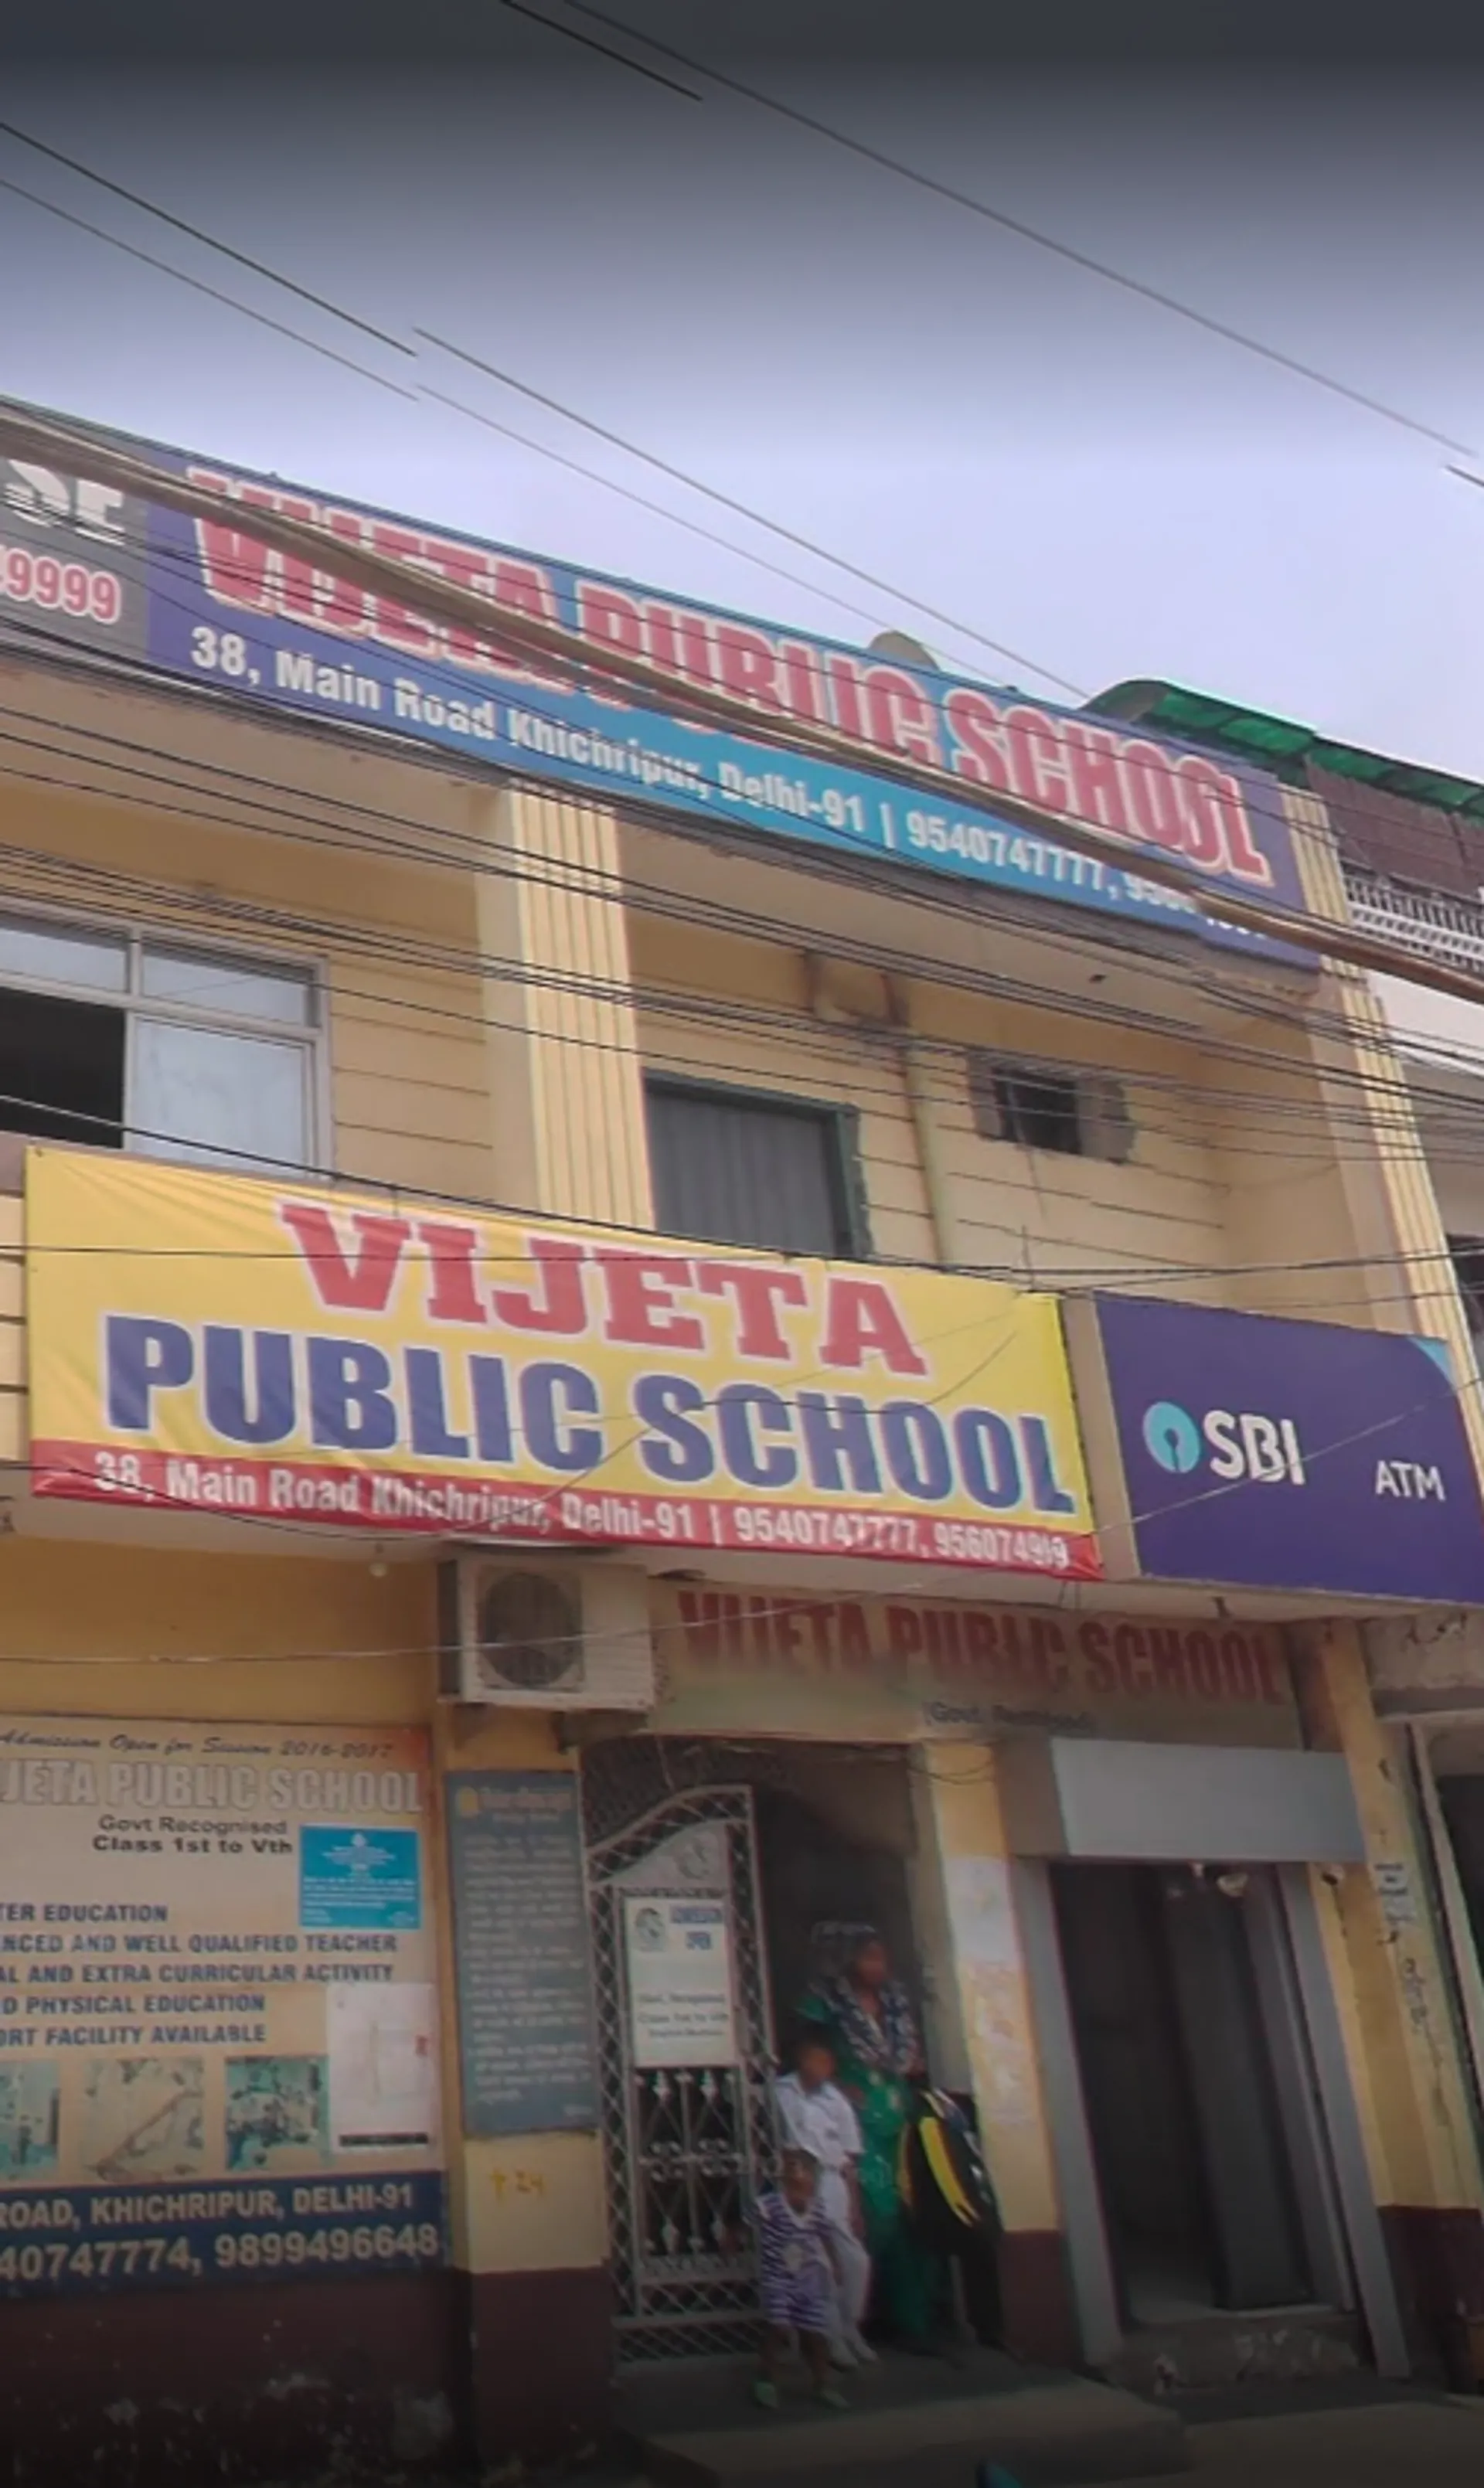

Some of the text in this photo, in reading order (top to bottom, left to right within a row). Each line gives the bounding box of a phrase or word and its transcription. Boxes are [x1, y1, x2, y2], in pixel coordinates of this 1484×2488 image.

[0, 544, 121, 625] 9999
[191, 627, 260, 686] 38,
[276, 651, 381, 710] Main
[394, 678, 495, 739] Road
[718, 761, 864, 832] Delhi-91
[906, 810, 1120, 900] 9540747777,
[274, 1198, 932, 1380] VIJETA
[102, 1311, 1079, 1516] PUBLIC SCHOOL
[1203, 1409, 1306, 1486] SBI
[94, 1451, 155, 1502] 38,
[165, 1458, 258, 1506] Main
[271, 1468, 361, 1513] Road
[561, 1492, 695, 1540] Delhi-91
[1375, 1460, 1446, 1502] ATM
[1076, 1622, 1287, 1705] SCHOOL
[107, 1762, 257, 1812] PUBLIC
[269, 1765, 424, 1814] SCHOOL
[92, 1834, 164, 1852] Class
[218, 1838, 243, 1853] to
[251, 1839, 293, 1854] Vth
[98, 1814, 288, 1836] Govt Recognised
[44, 1904, 168, 1922] EDUCATION
[72, 1935, 117, 1952] AND
[124, 1935, 182, 1952] WELL
[189, 1935, 299, 1953] QUALIFIED
[305, 1935, 397, 1953] TEACHER
[28, 1965, 74, 1983] AND
[82, 1964, 151, 1983] EXTRA
[158, 1964, 297, 1983] CURRICULAR
[304, 1964, 393, 1983] ACTIVITY
[26, 1996, 135, 2014] PHYSICAL
[145, 1993, 266, 2013] EDUCATION
[46, 2026, 142, 2045] FACILITY
[151, 2023, 267, 2044] AVAILABLE
[90, 2189, 284, 2225] KHICHRIPUR,
[293, 2183, 412, 2214] DELHI-91
[214, 2223, 438, 2268] 9899496648
